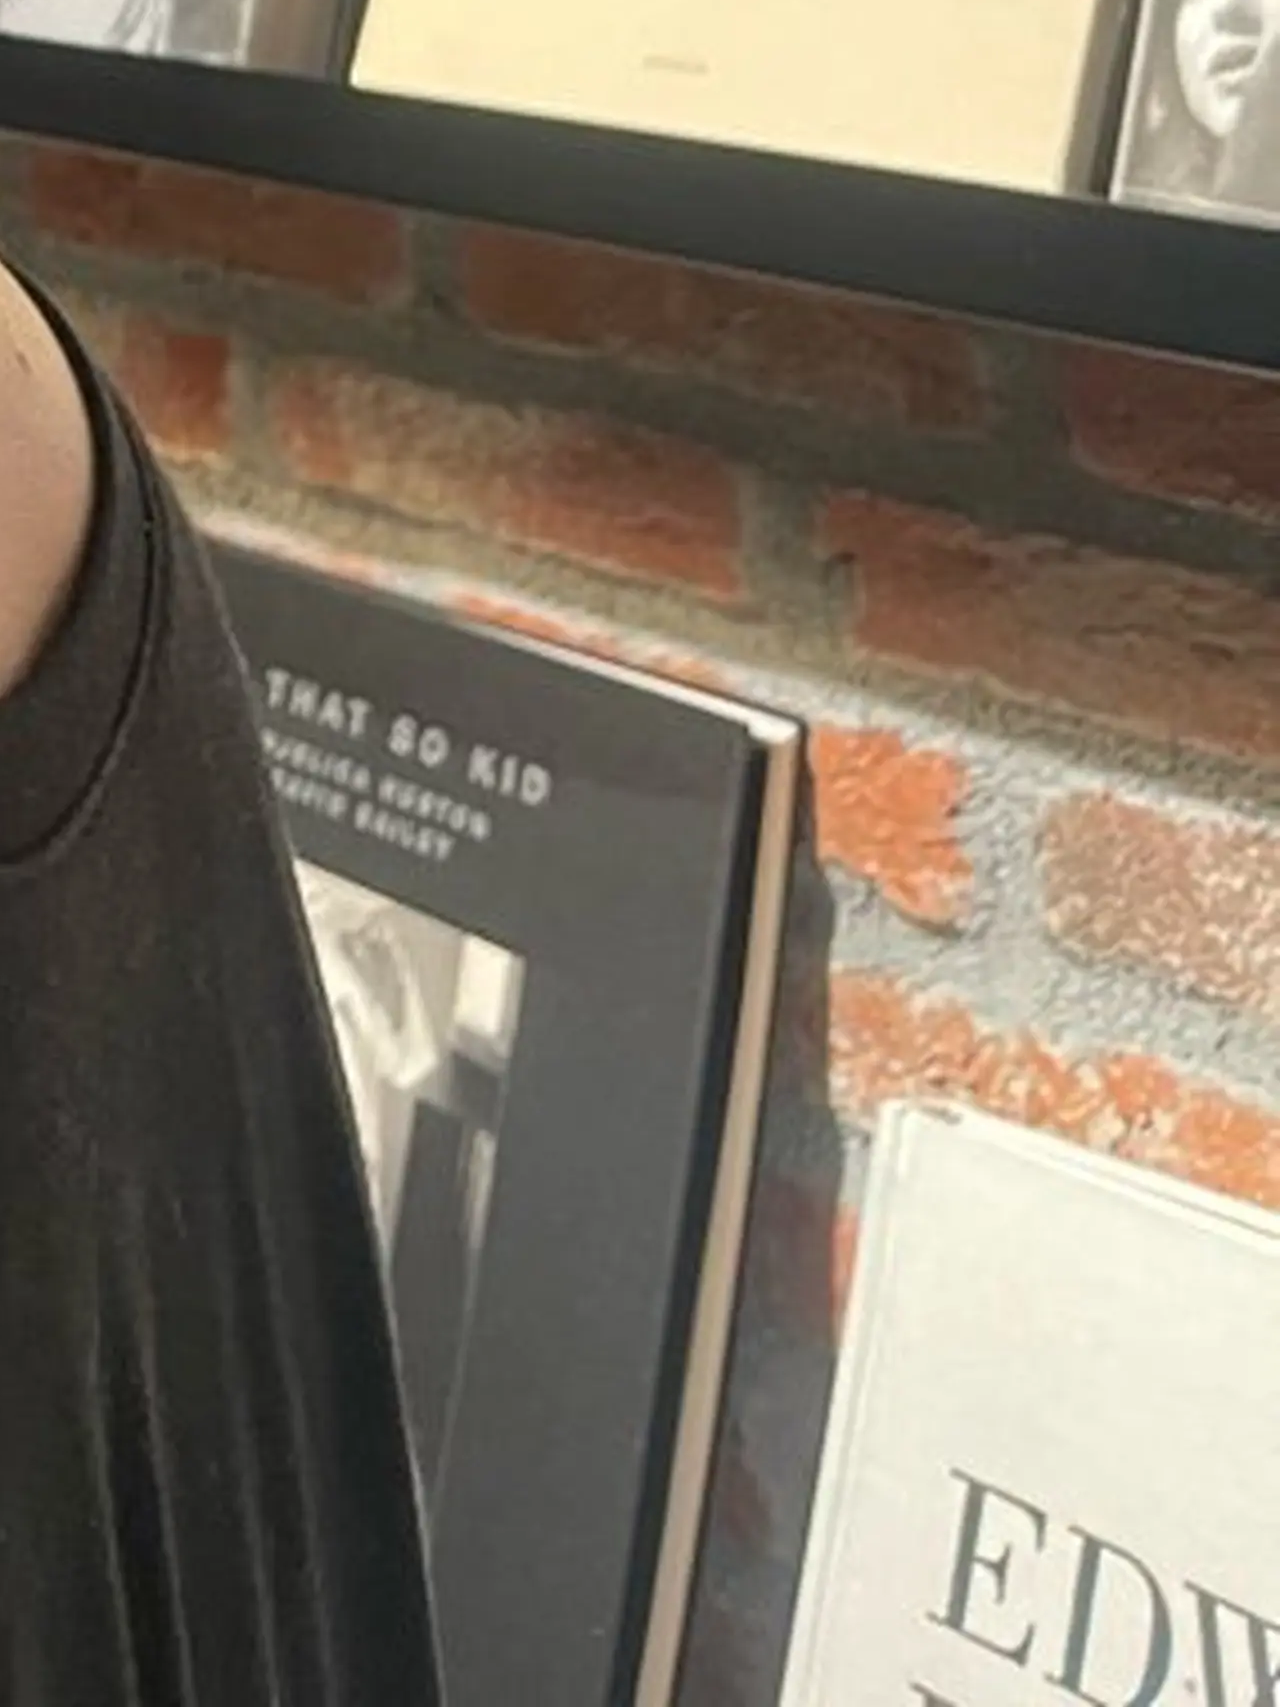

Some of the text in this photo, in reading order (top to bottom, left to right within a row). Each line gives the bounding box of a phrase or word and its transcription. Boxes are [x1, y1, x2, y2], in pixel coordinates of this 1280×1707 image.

[265, 668, 552, 806] THAT SO KID
